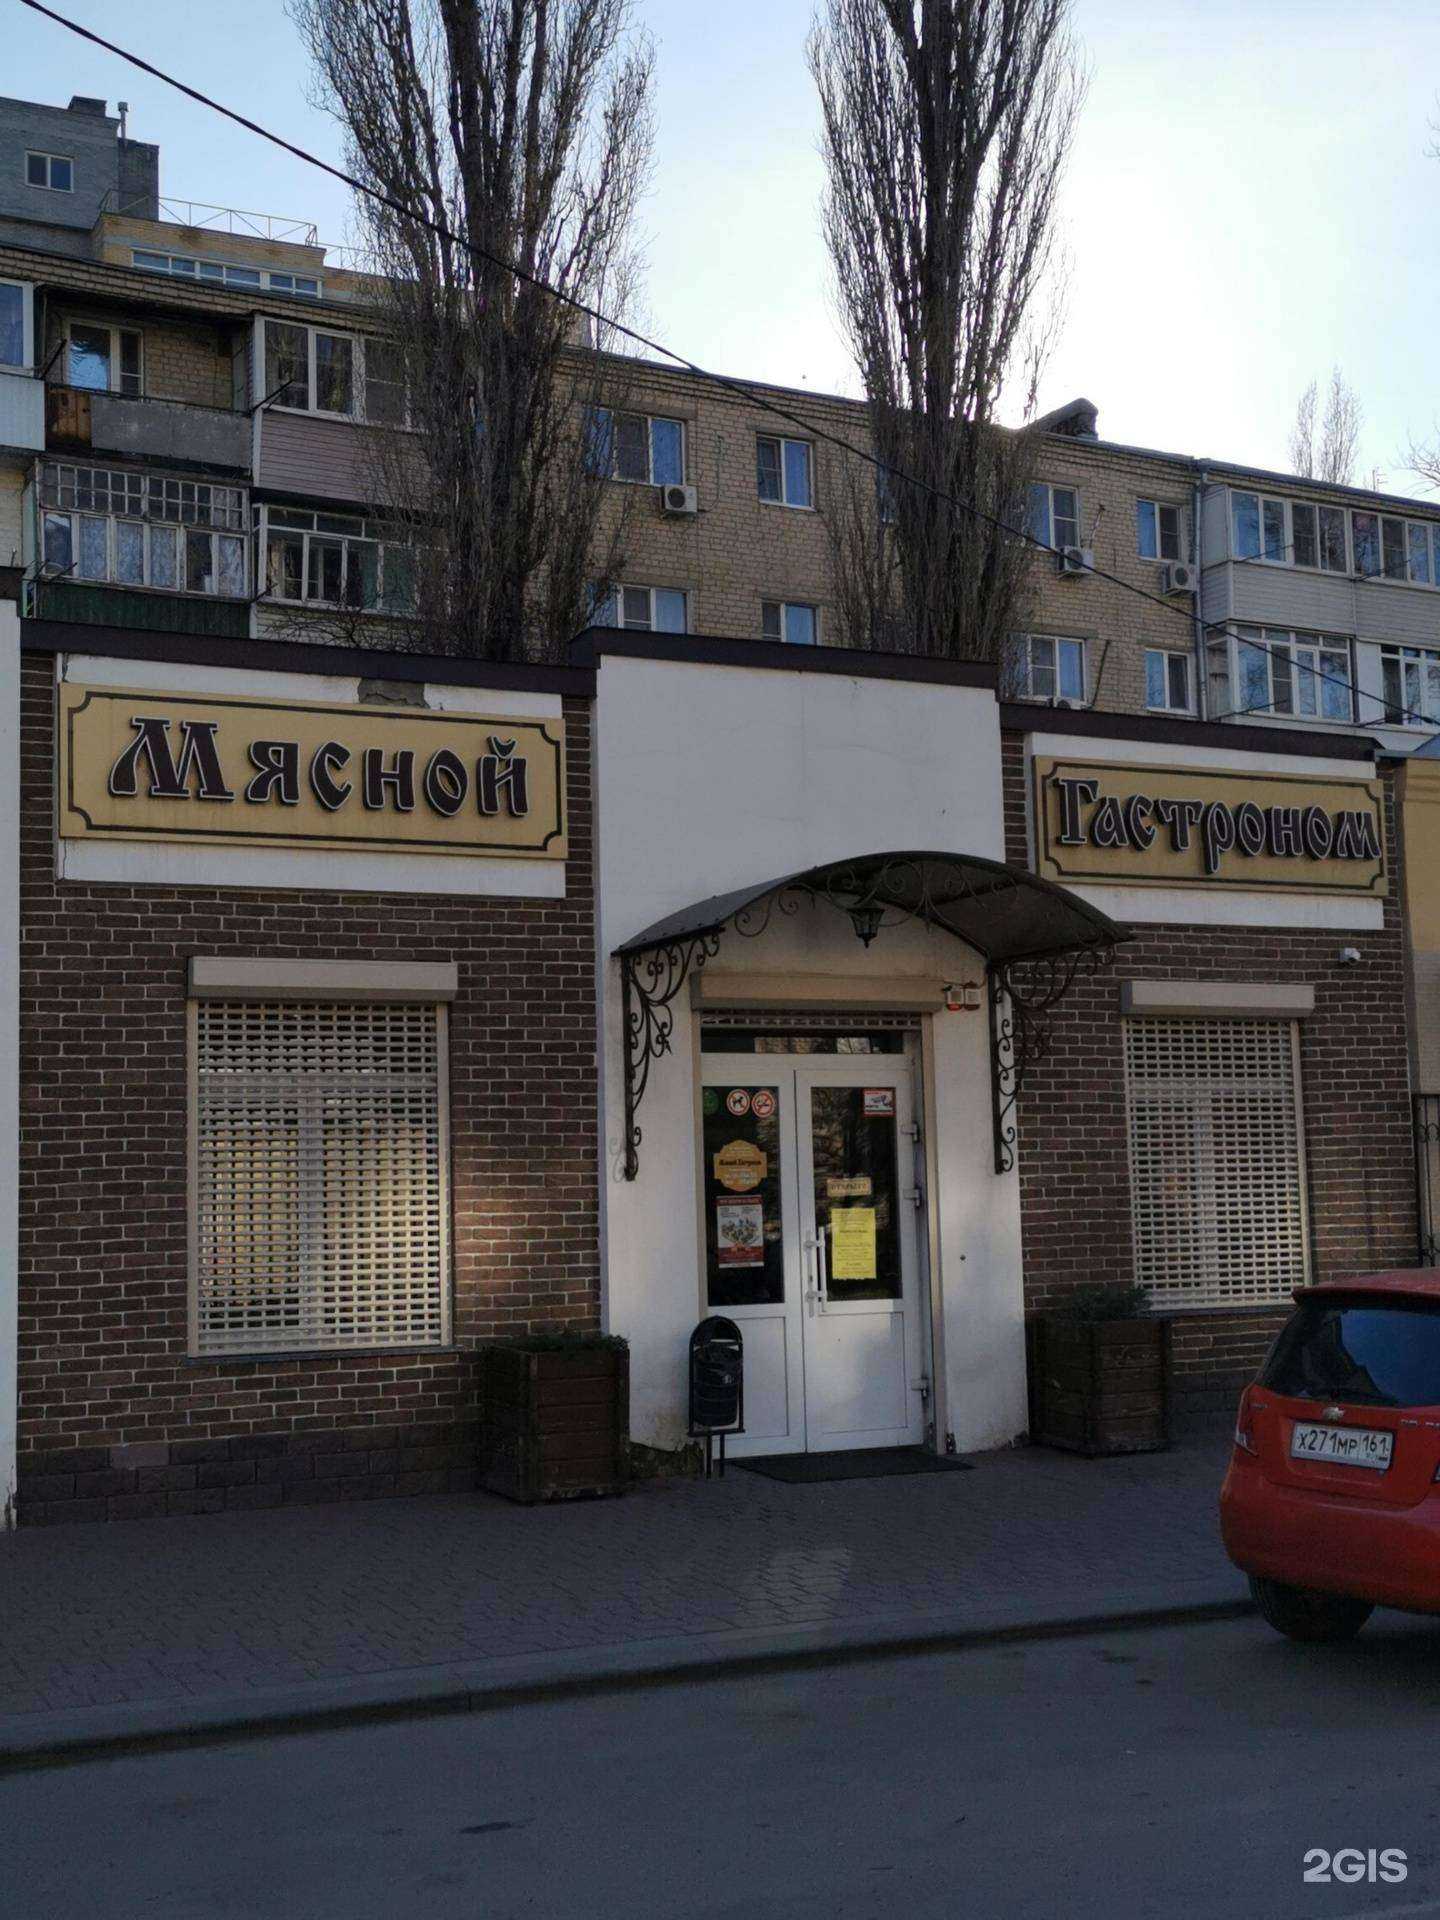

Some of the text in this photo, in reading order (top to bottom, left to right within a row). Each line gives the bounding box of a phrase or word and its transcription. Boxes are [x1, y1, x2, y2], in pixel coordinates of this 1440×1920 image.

[109, 717, 528, 816] Мясной
[1054, 777, 1382, 874] Гастроном
[1363, 1435, 1387, 1455] 161
